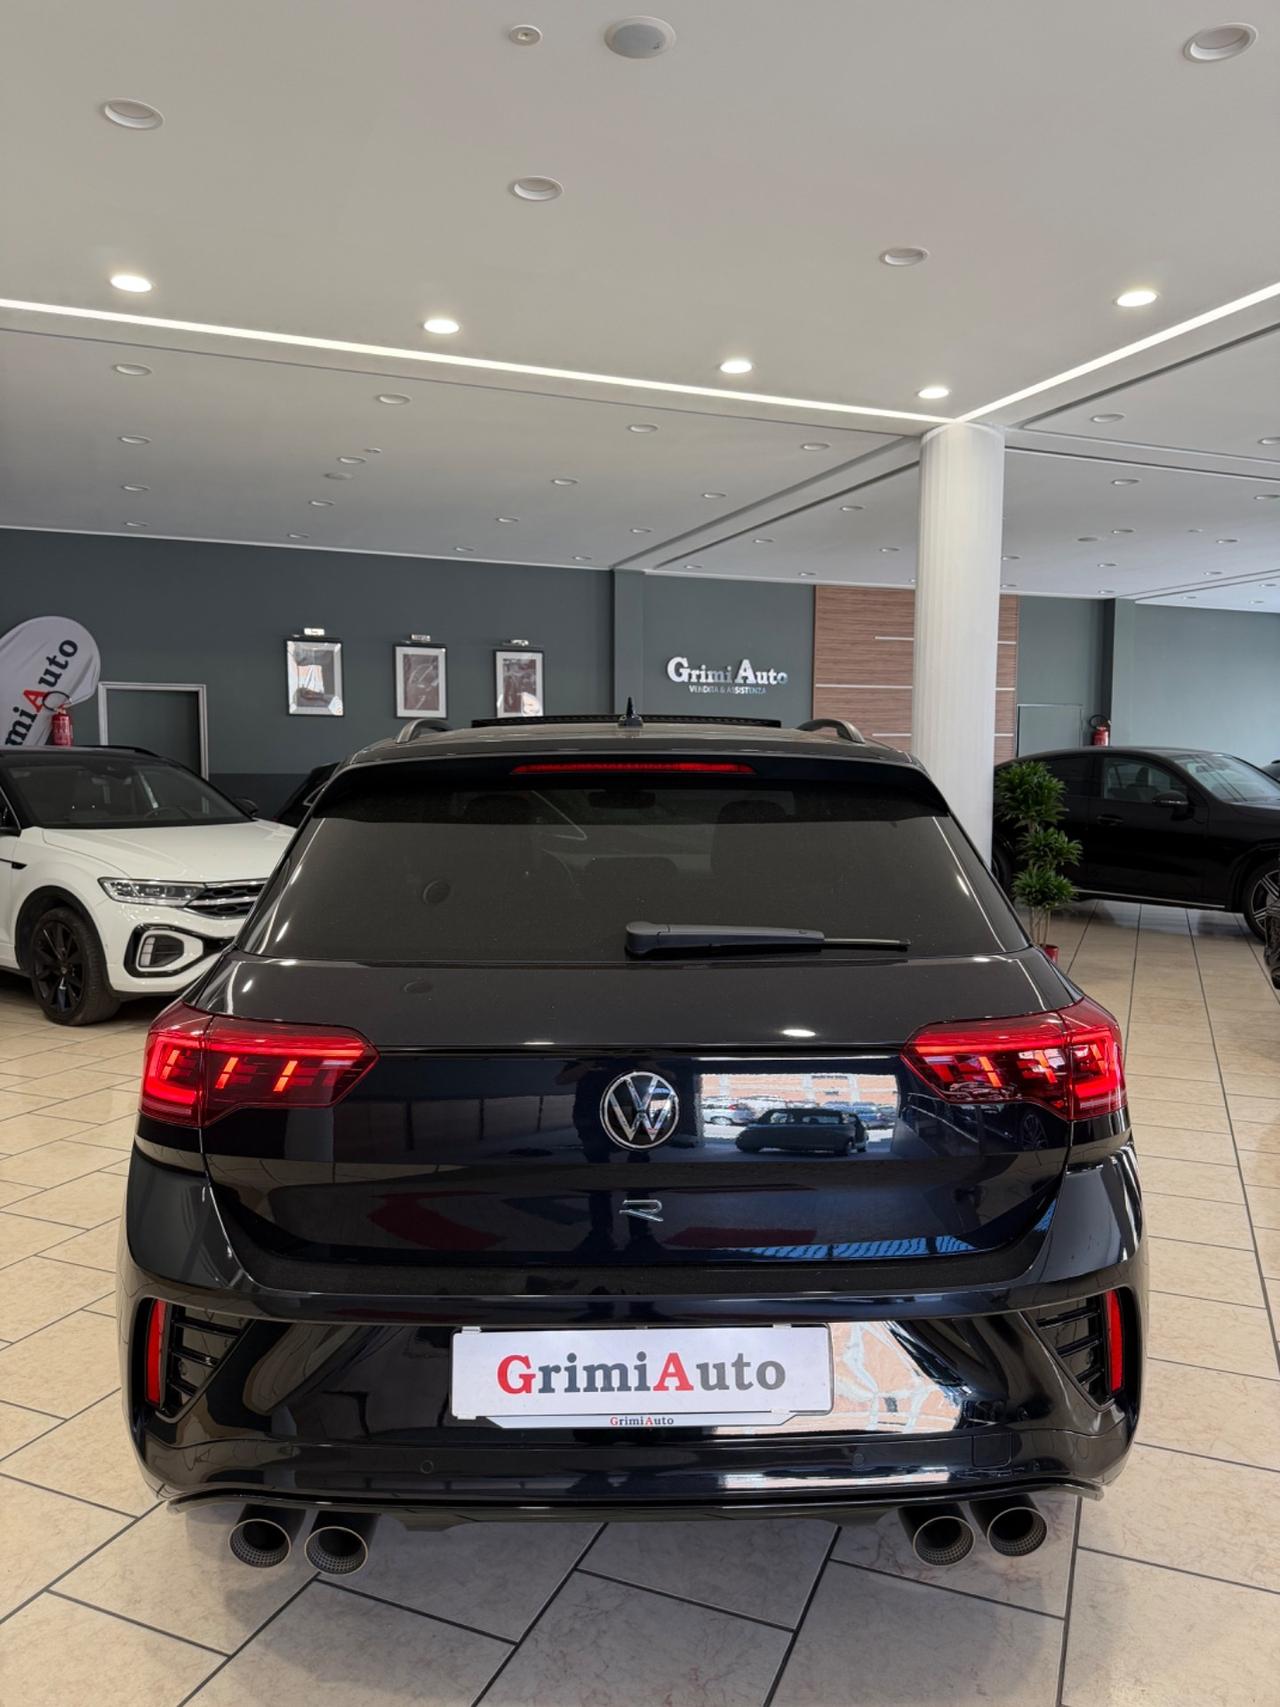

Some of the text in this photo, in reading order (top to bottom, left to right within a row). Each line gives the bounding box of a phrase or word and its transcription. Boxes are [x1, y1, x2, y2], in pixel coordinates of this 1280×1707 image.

[667, 657, 788, 684] Grimi Auto
[497, 1351, 786, 1394] GrimiAuto
[610, 1416, 674, 1425] GrimiAuto
